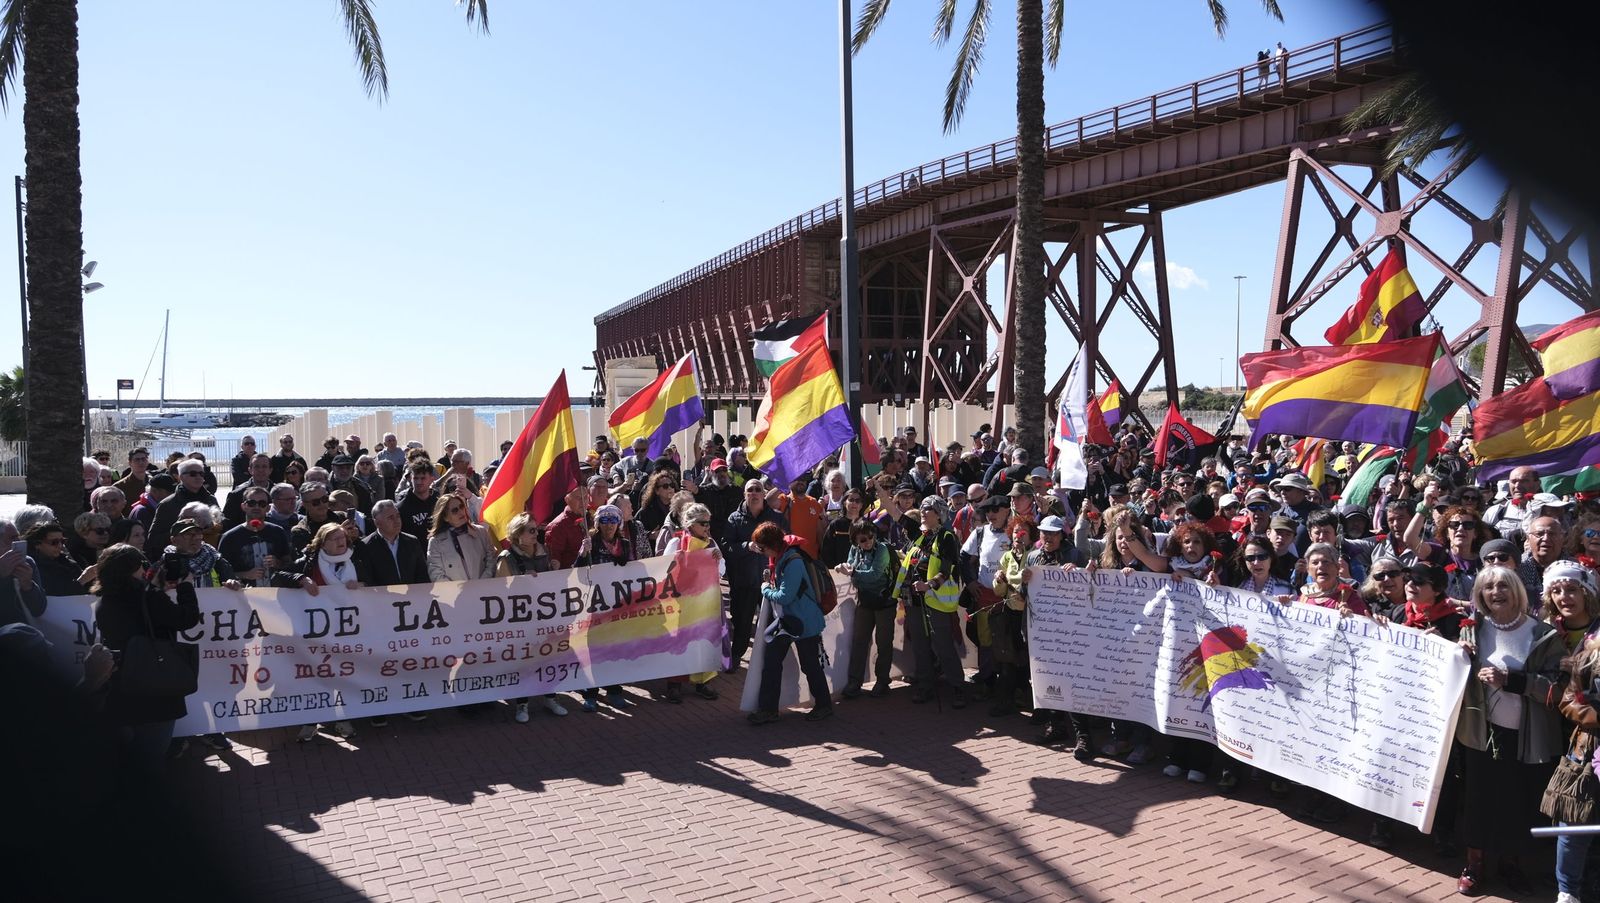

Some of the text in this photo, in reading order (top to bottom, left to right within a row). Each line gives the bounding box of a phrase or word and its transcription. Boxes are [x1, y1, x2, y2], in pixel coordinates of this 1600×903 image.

[72, 561, 682, 646] MCHA DE LA DESBANDÁ
[1043, 570, 1111, 586] HOMENAJE
[1114, 575, 1122, 586] A
[1124, 576, 1148, 589] LAS
[1205, 588, 1222, 603] DE
[1246, 596, 1332, 628] CARRETERA
[1337, 618, 1359, 636] DE
[1363, 622, 1382, 642] LA
[1386, 628, 1446, 660] MUERTE
[203, 604, 682, 660] nuestras vidas, que no rompan nuestra memoria.
[213, 661, 581, 720] CARRETERA DE LA MUERTE 1937
[230, 640, 570, 685] No más genocidios
[1166, 716, 1188, 726] ASC
[1195, 720, 1209, 730] LA
[1327, 754, 1361, 774] tantas
